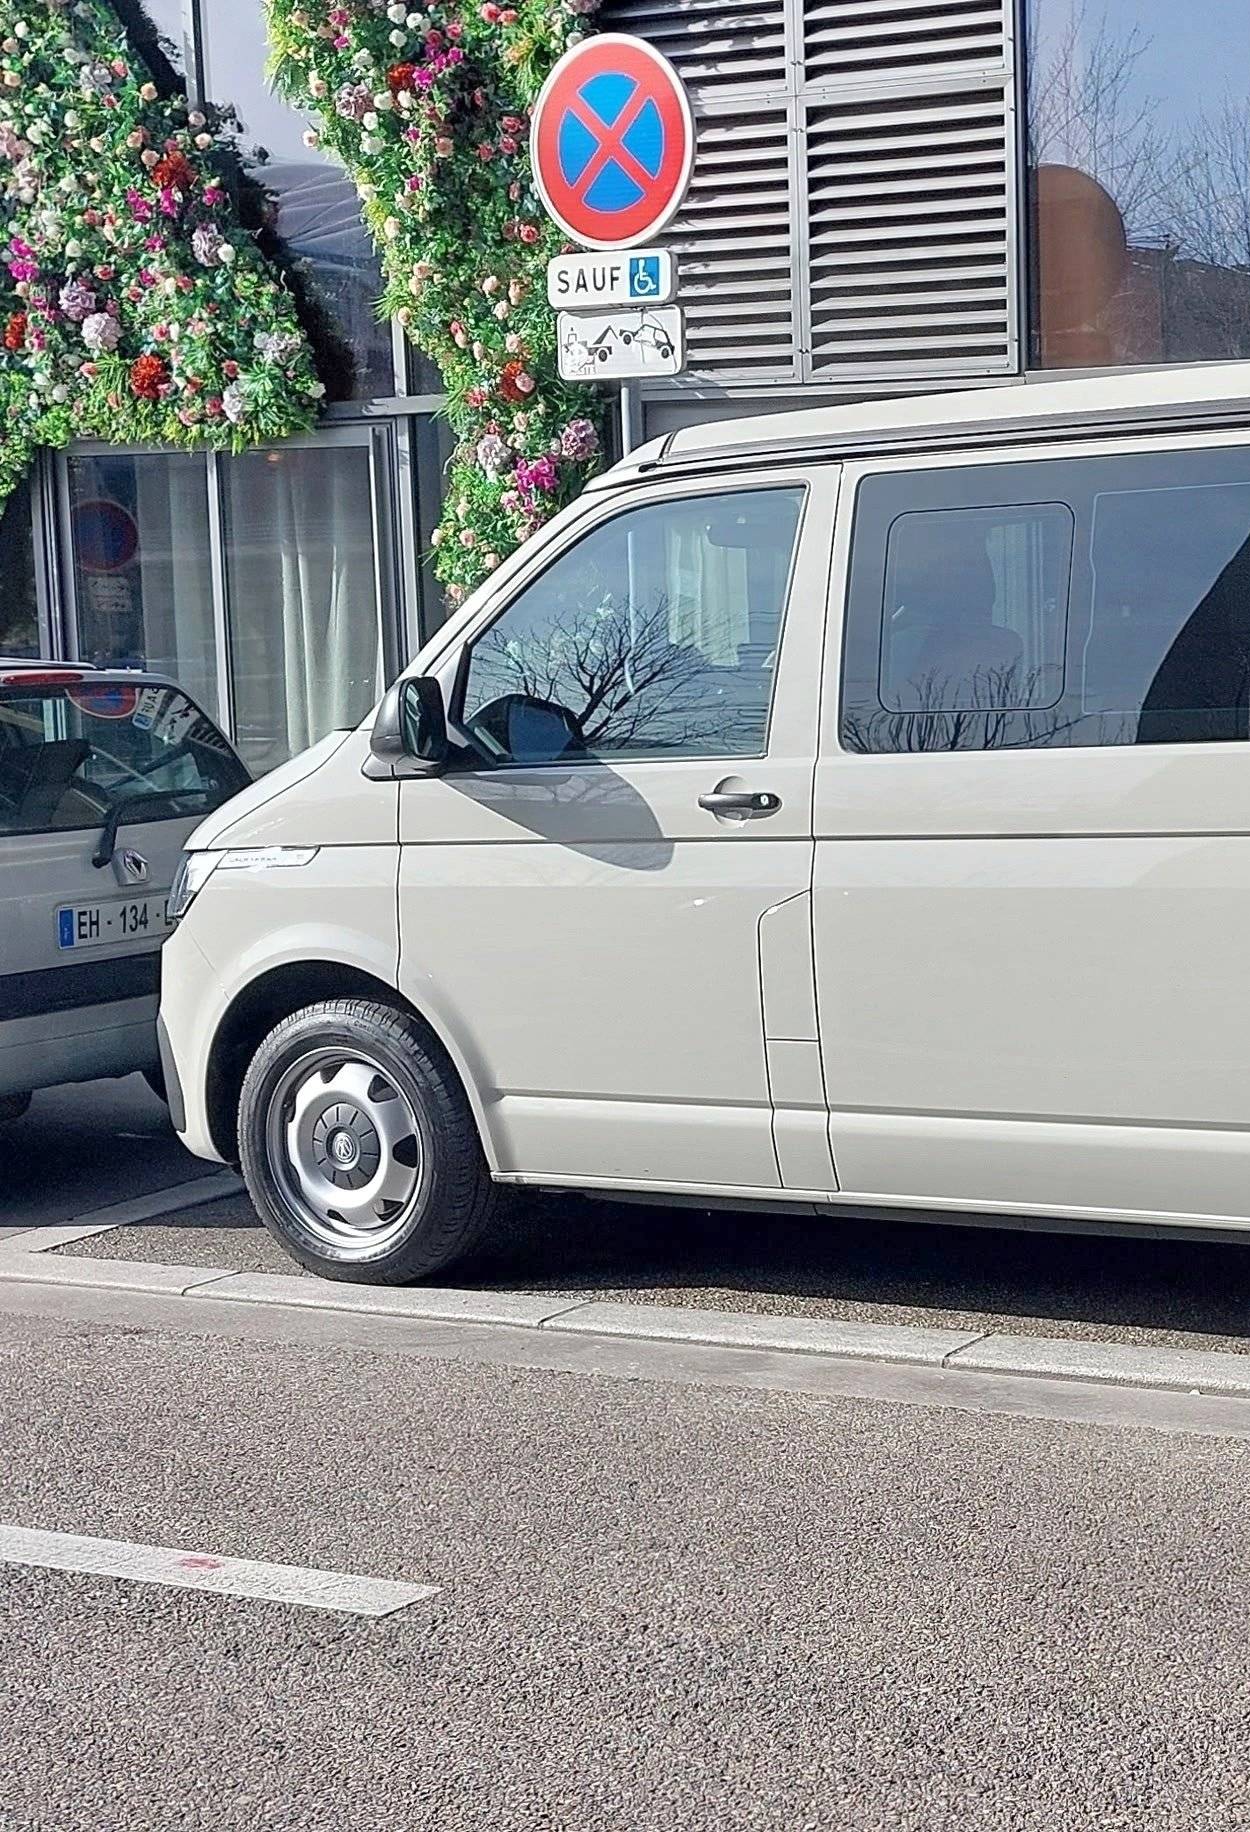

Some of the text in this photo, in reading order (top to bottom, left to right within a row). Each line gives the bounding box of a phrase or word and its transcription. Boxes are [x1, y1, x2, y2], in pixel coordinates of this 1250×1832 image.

[558, 266, 621, 294] SAUF
[78, 909, 100, 939] EH
[120, 903, 149, 933] 134
